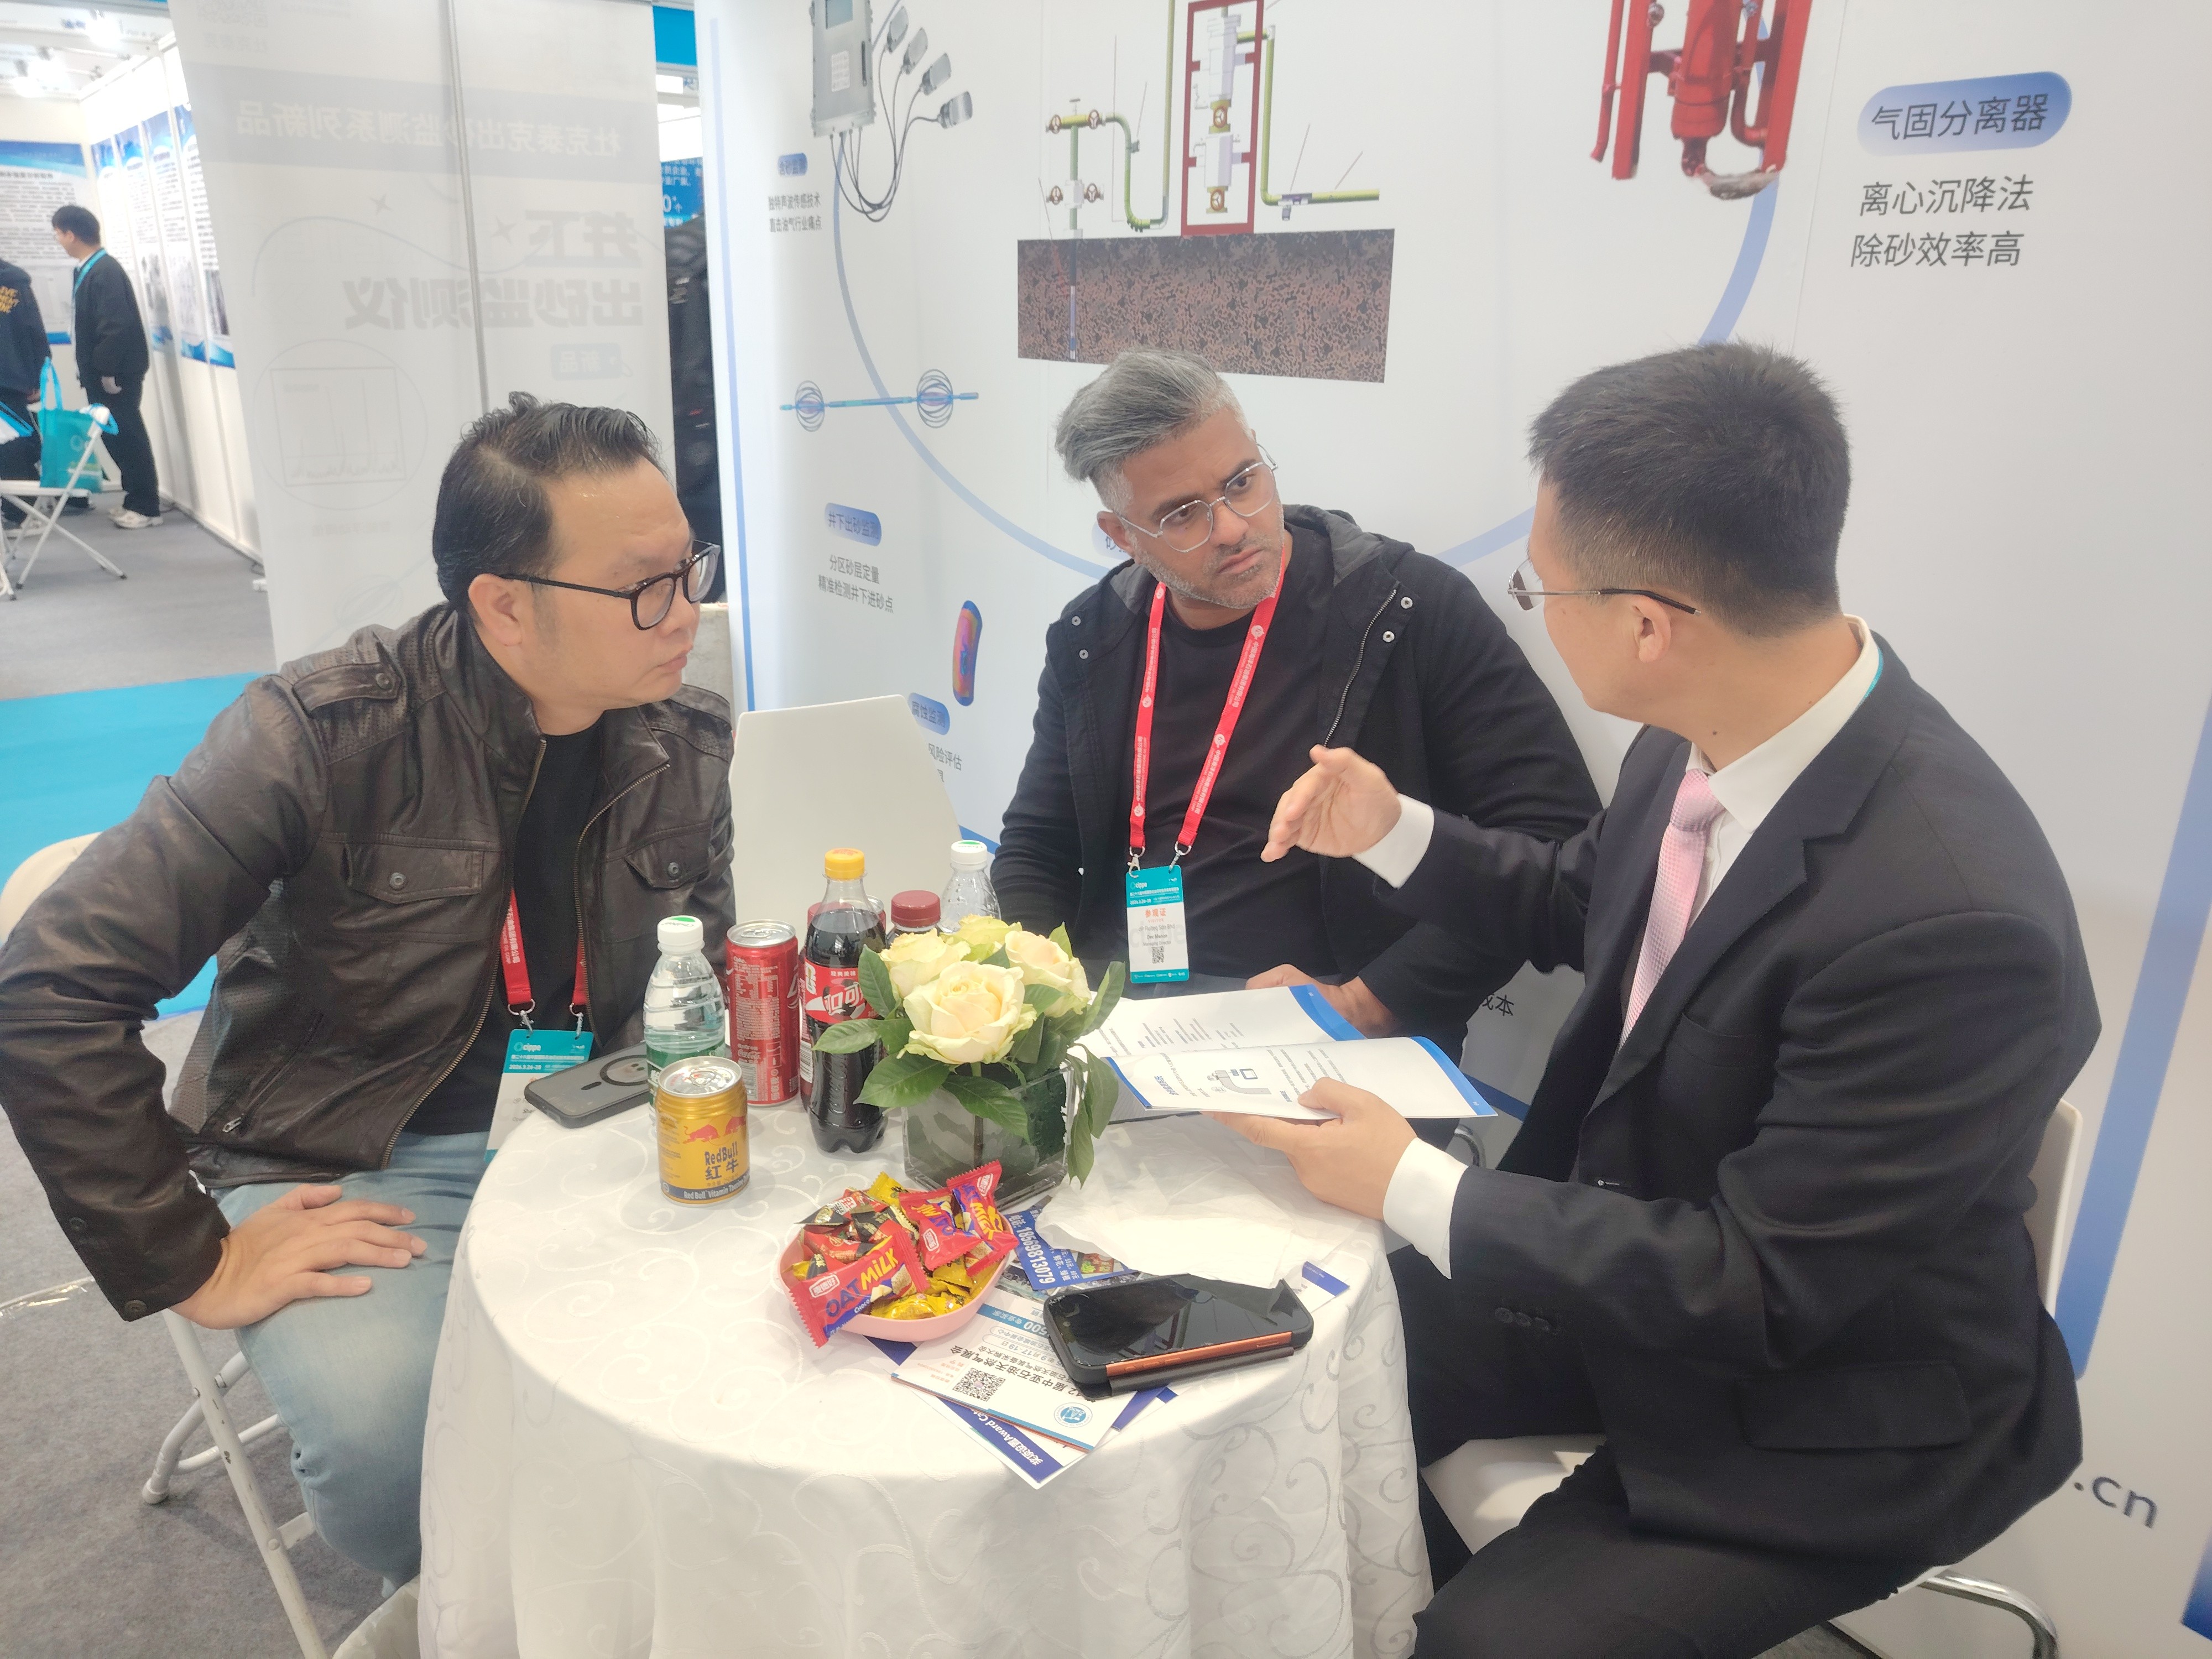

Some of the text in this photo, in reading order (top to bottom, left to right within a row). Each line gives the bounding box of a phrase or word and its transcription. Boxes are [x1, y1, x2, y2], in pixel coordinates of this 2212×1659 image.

[1870, 93, 2049, 140] 气固分离器
[1860, 174, 2034, 217] 离心沉降法
[1850, 230, 2025, 267] 除砂效率高
[828, 511, 879, 540] 井下出砂监测
[829, 555, 880, 585] 分区砂层定量
[818, 574, 894, 614] 精准检测井下进砂点
[928, 743, 962, 771] 风险评估
[705, 1158, 739, 1181] 红牛
[683, 1191, 694, 1199] Red
[708, 1186, 729, 1198] Vitamin
[1016, 1226, 1056, 1285] 18569813079
[825, 1277, 862, 1318] OAT
[992, 1308, 1024, 1326] 专业买家
[2073, 1475, 2158, 1529] .cn
